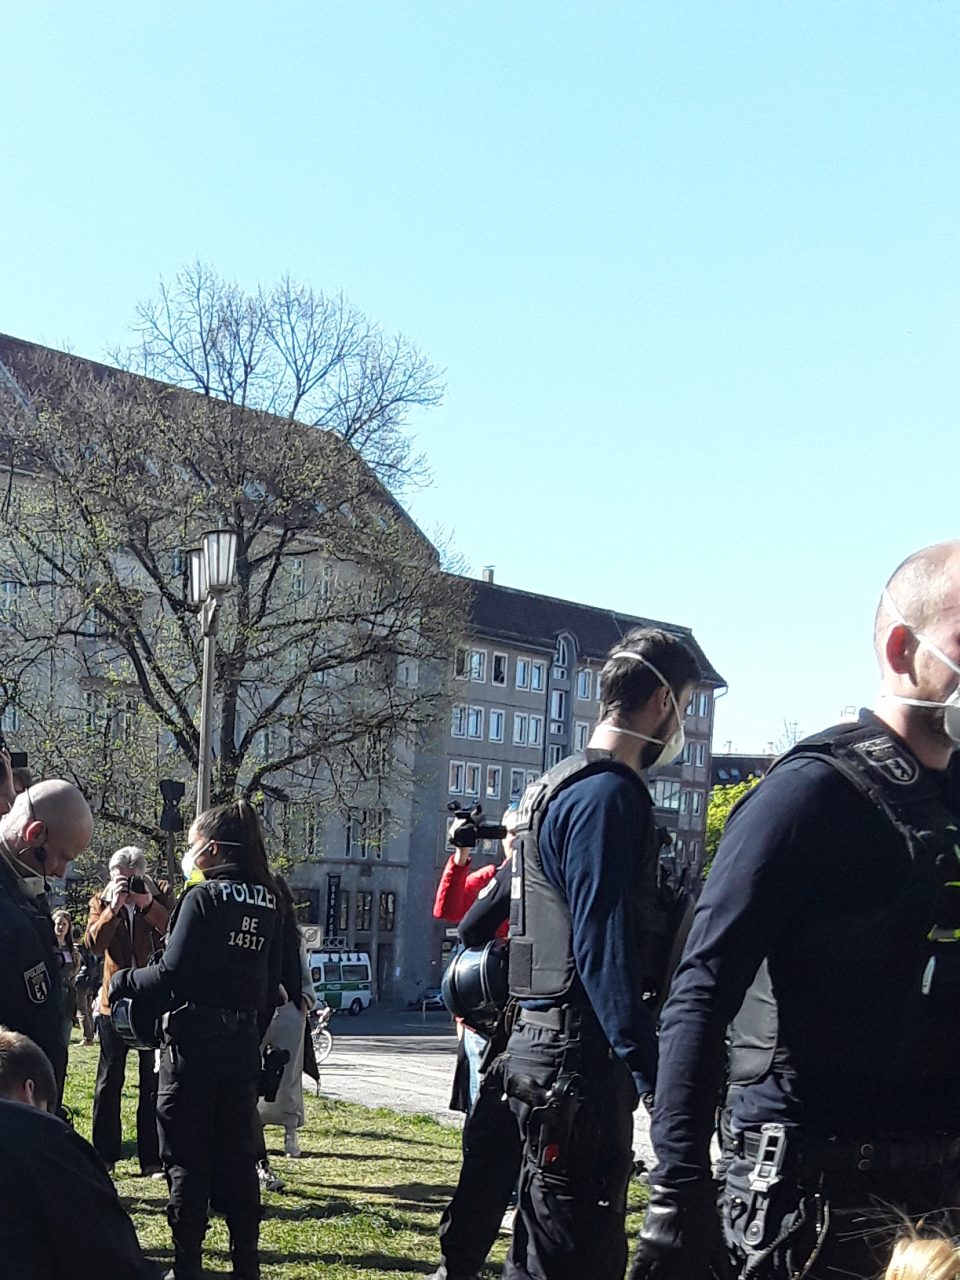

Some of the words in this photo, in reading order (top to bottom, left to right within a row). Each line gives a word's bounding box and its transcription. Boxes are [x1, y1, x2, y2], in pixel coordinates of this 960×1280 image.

[219, 882, 276, 910] POLIZEI
[241, 916, 259, 933] BE
[227, 931, 265, 951] 14317
